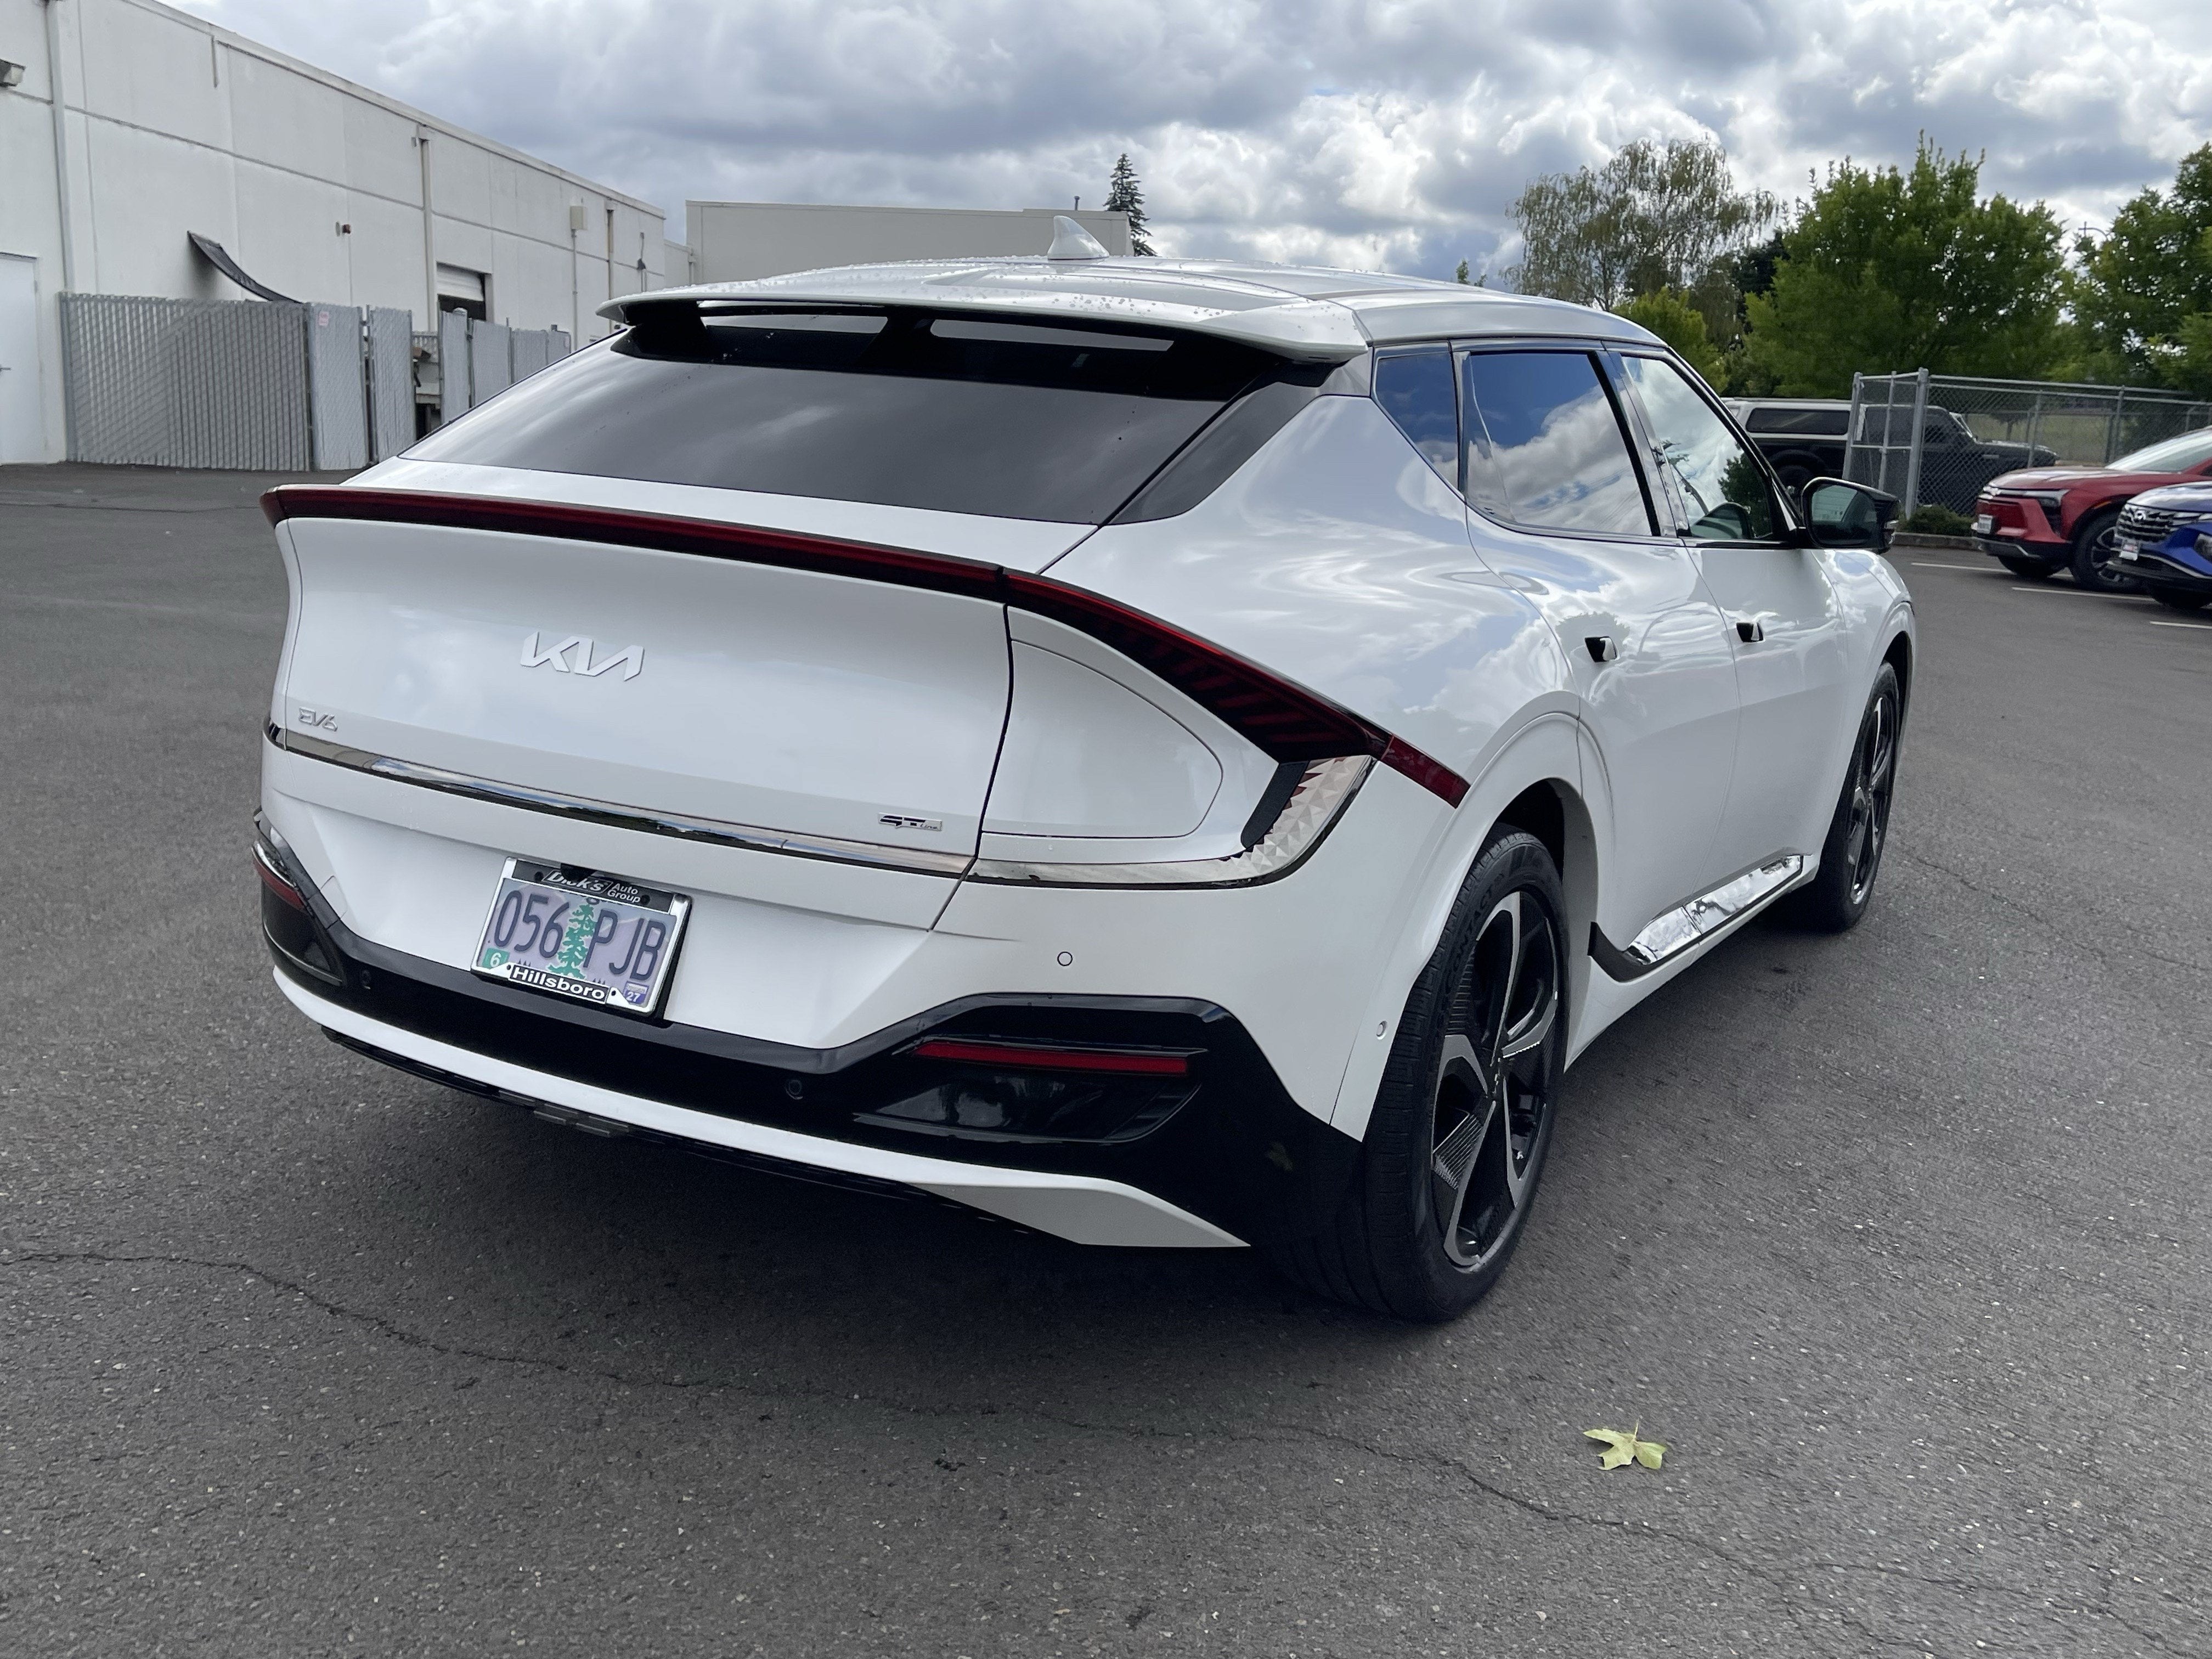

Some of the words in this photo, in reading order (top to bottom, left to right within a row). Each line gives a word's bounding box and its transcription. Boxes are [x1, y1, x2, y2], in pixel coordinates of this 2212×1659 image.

[521, 631, 645, 681] KIA
[298, 706, 338, 732] EV6
[607, 890, 641, 904] Group
[612, 883, 639, 895] Auto
[494, 890, 571, 958] 056
[583, 909, 666, 981] PJB
[490, 952, 500, 967] 6
[512, 966, 605, 1000] Hillsboro
[626, 991, 641, 1002] 27
